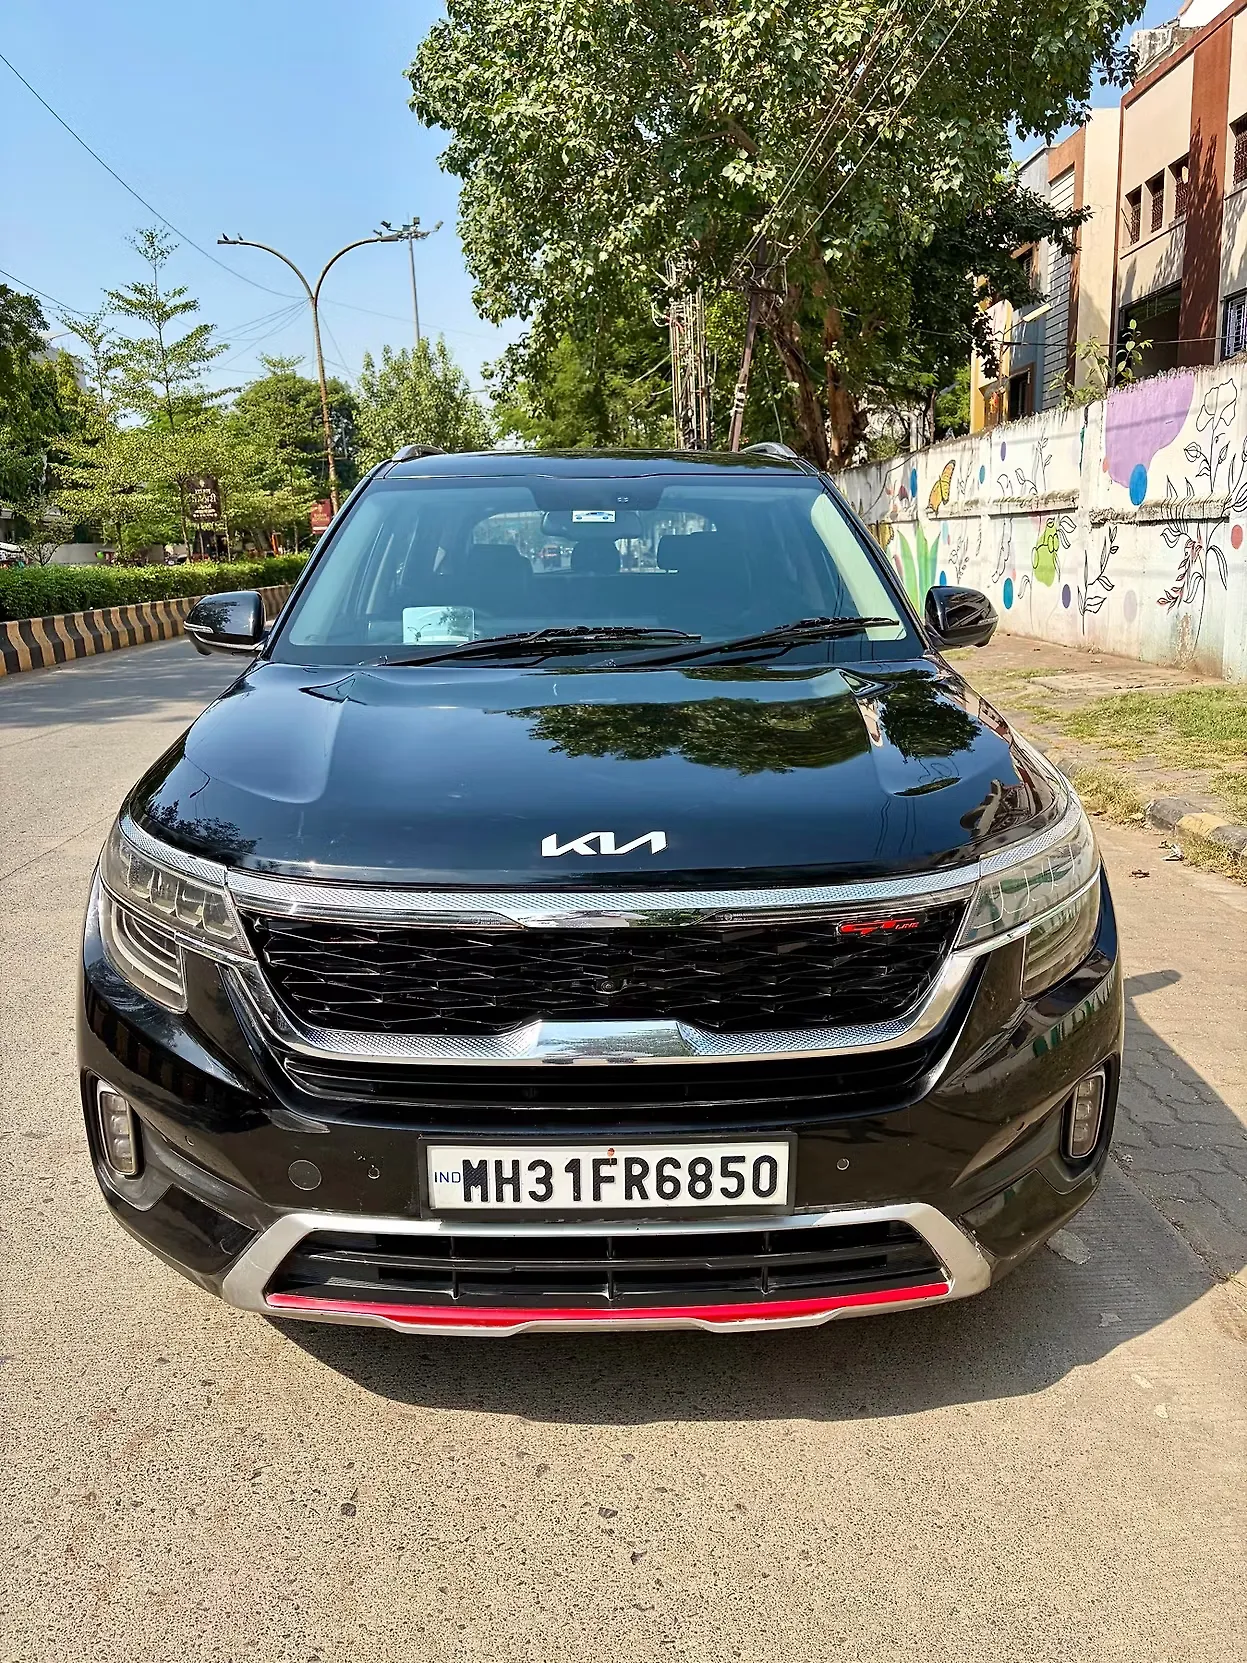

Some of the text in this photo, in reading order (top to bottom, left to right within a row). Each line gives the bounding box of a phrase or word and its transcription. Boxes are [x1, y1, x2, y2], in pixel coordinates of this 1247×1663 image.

[541, 831, 667, 857] KIA
[434, 1154, 778, 1203] IND MH31FR6850
